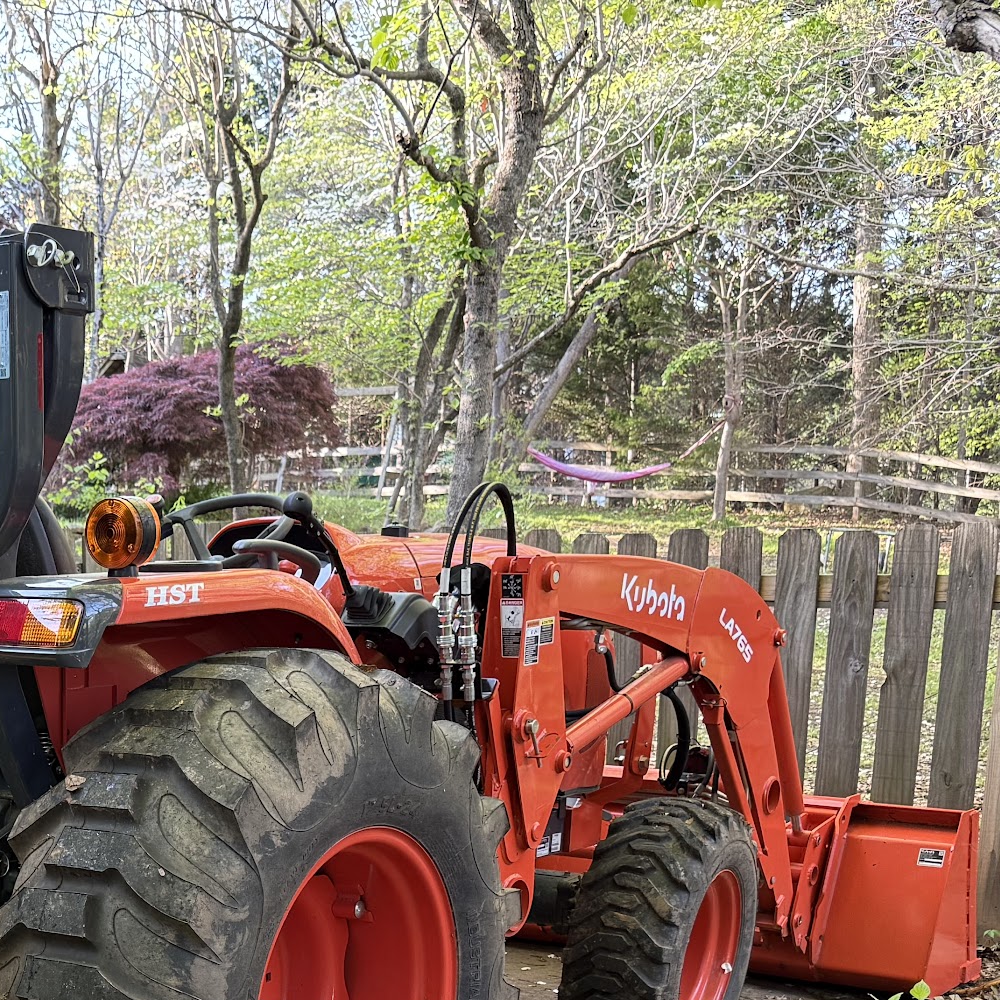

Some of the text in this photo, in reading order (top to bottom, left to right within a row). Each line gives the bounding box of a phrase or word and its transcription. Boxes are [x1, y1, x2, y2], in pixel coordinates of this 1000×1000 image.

[144, 582, 205, 607] HST
[620, 572, 686, 621] Kubota
[719, 607, 754, 664] LA765
